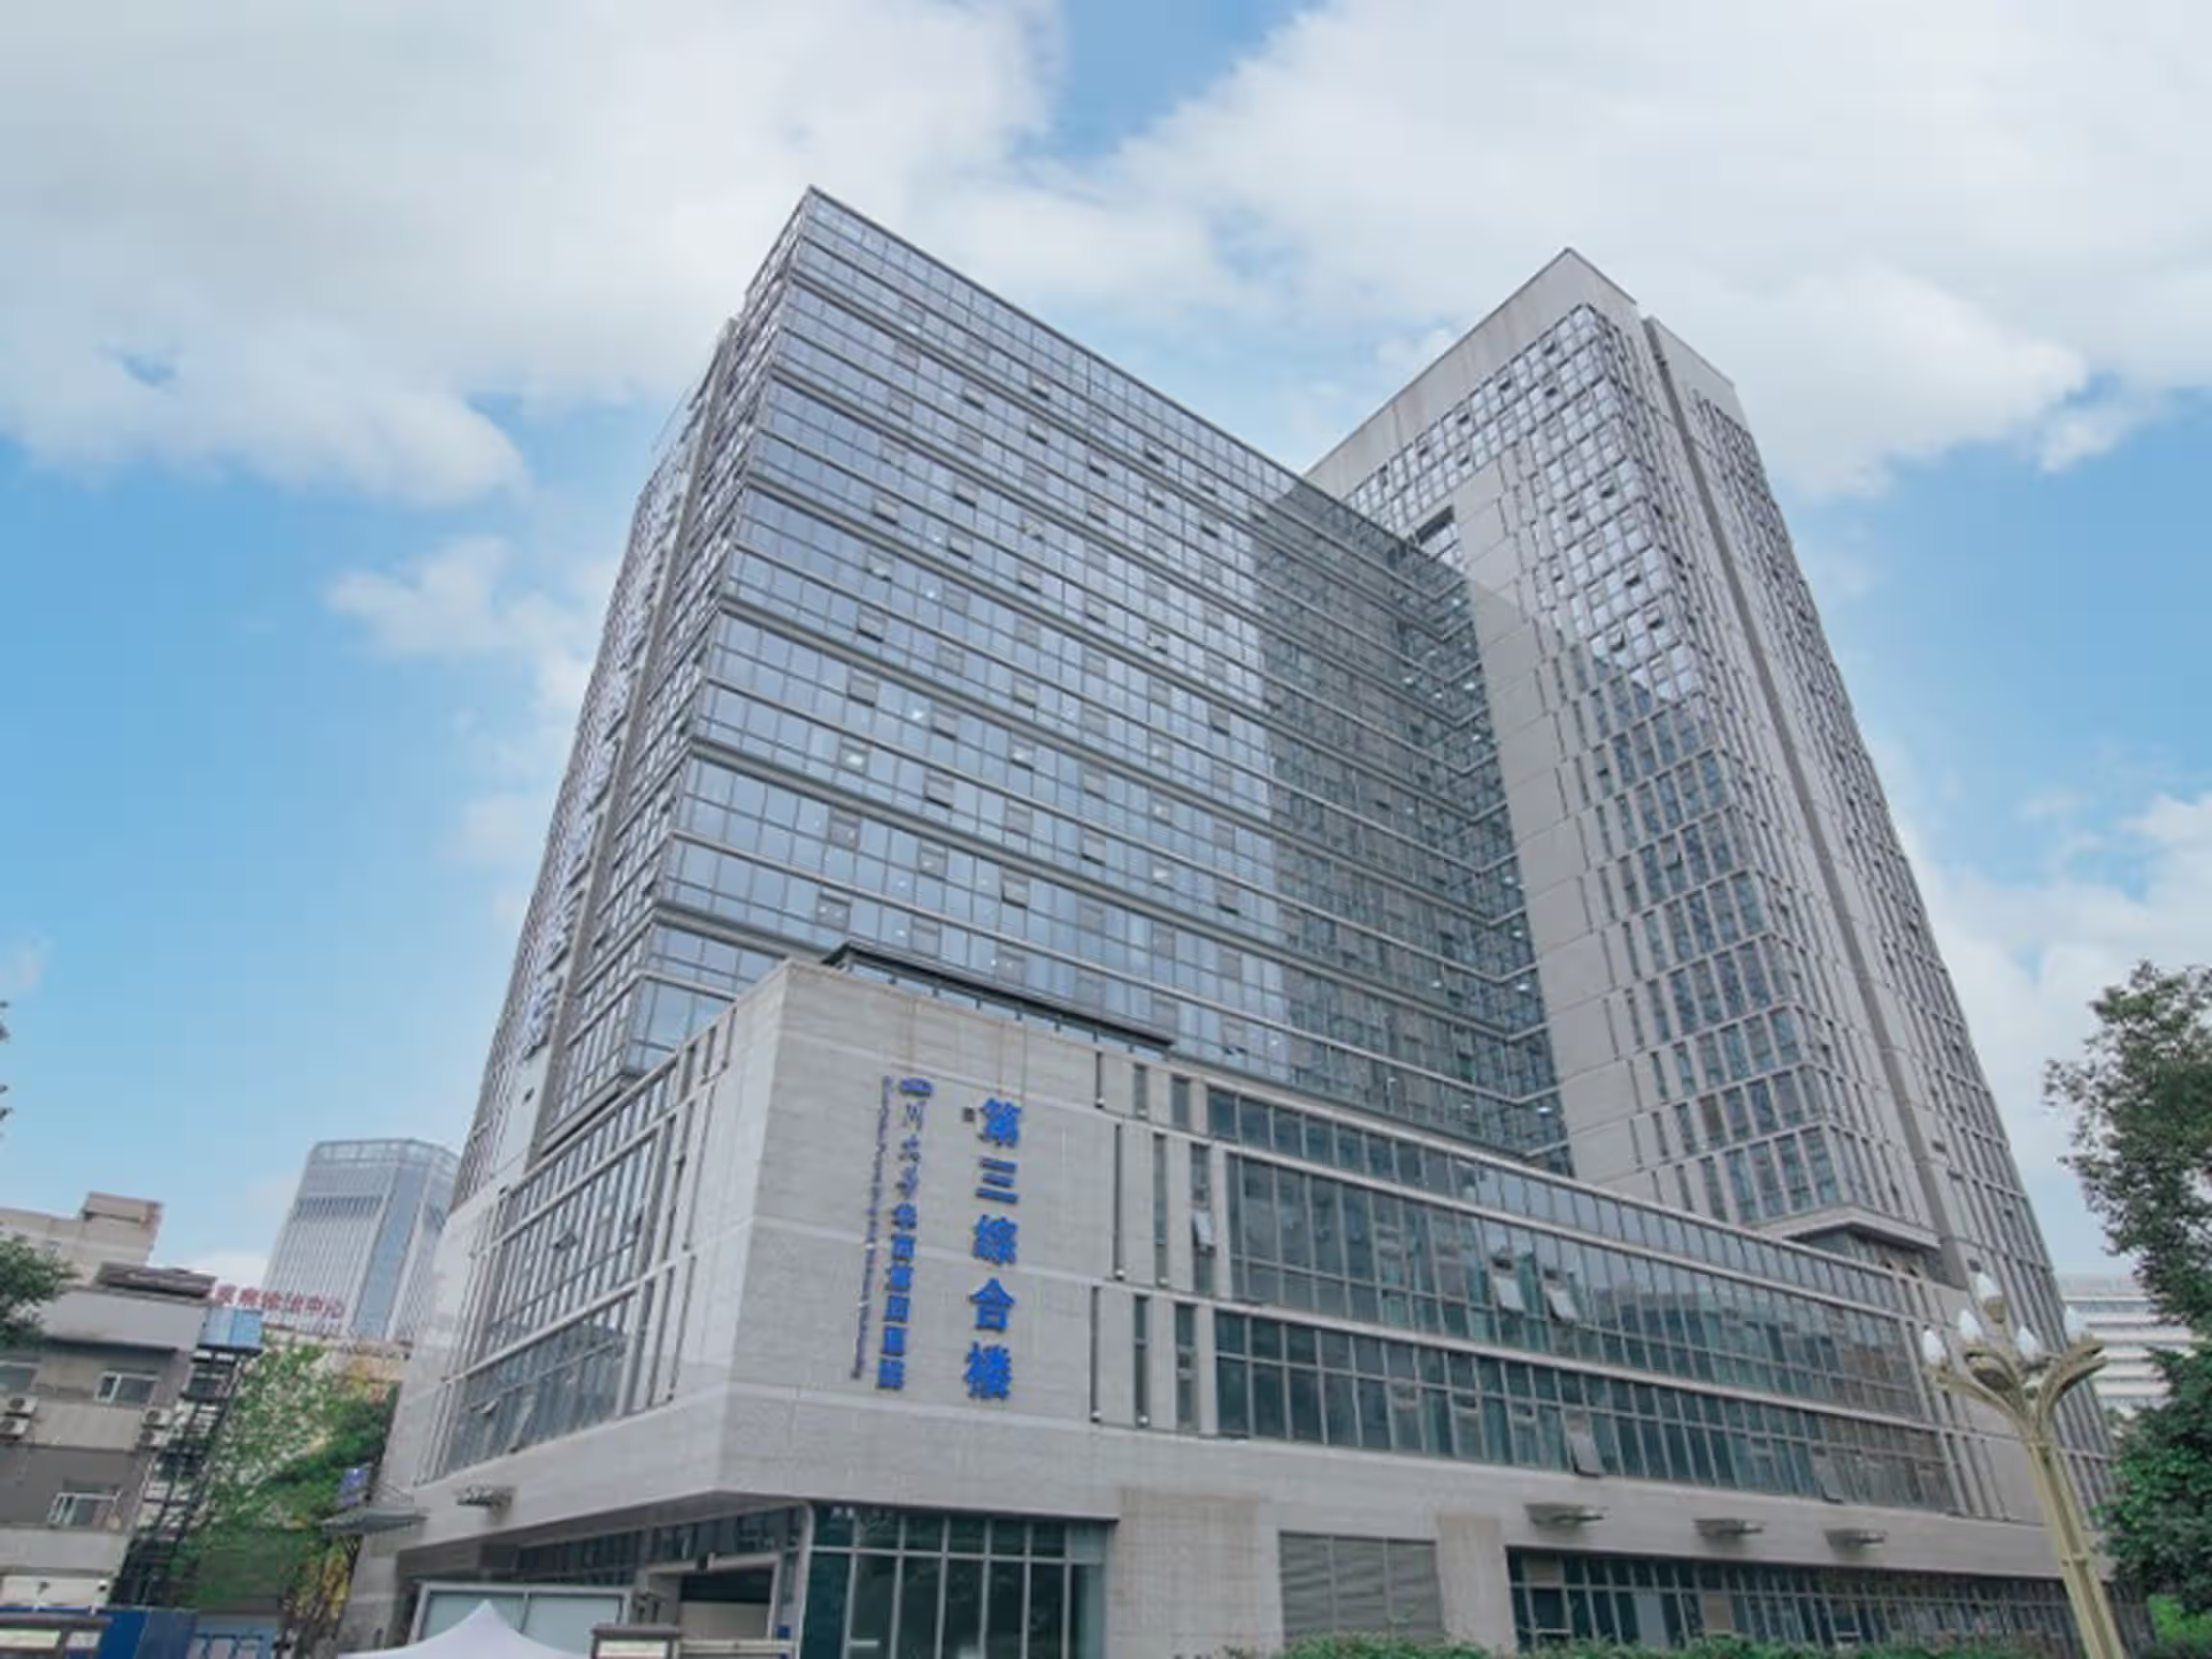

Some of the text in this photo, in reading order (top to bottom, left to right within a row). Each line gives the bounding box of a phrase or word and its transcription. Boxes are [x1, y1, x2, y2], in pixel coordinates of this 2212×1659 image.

[962, 1096, 1022, 1401] 第三综合楼
